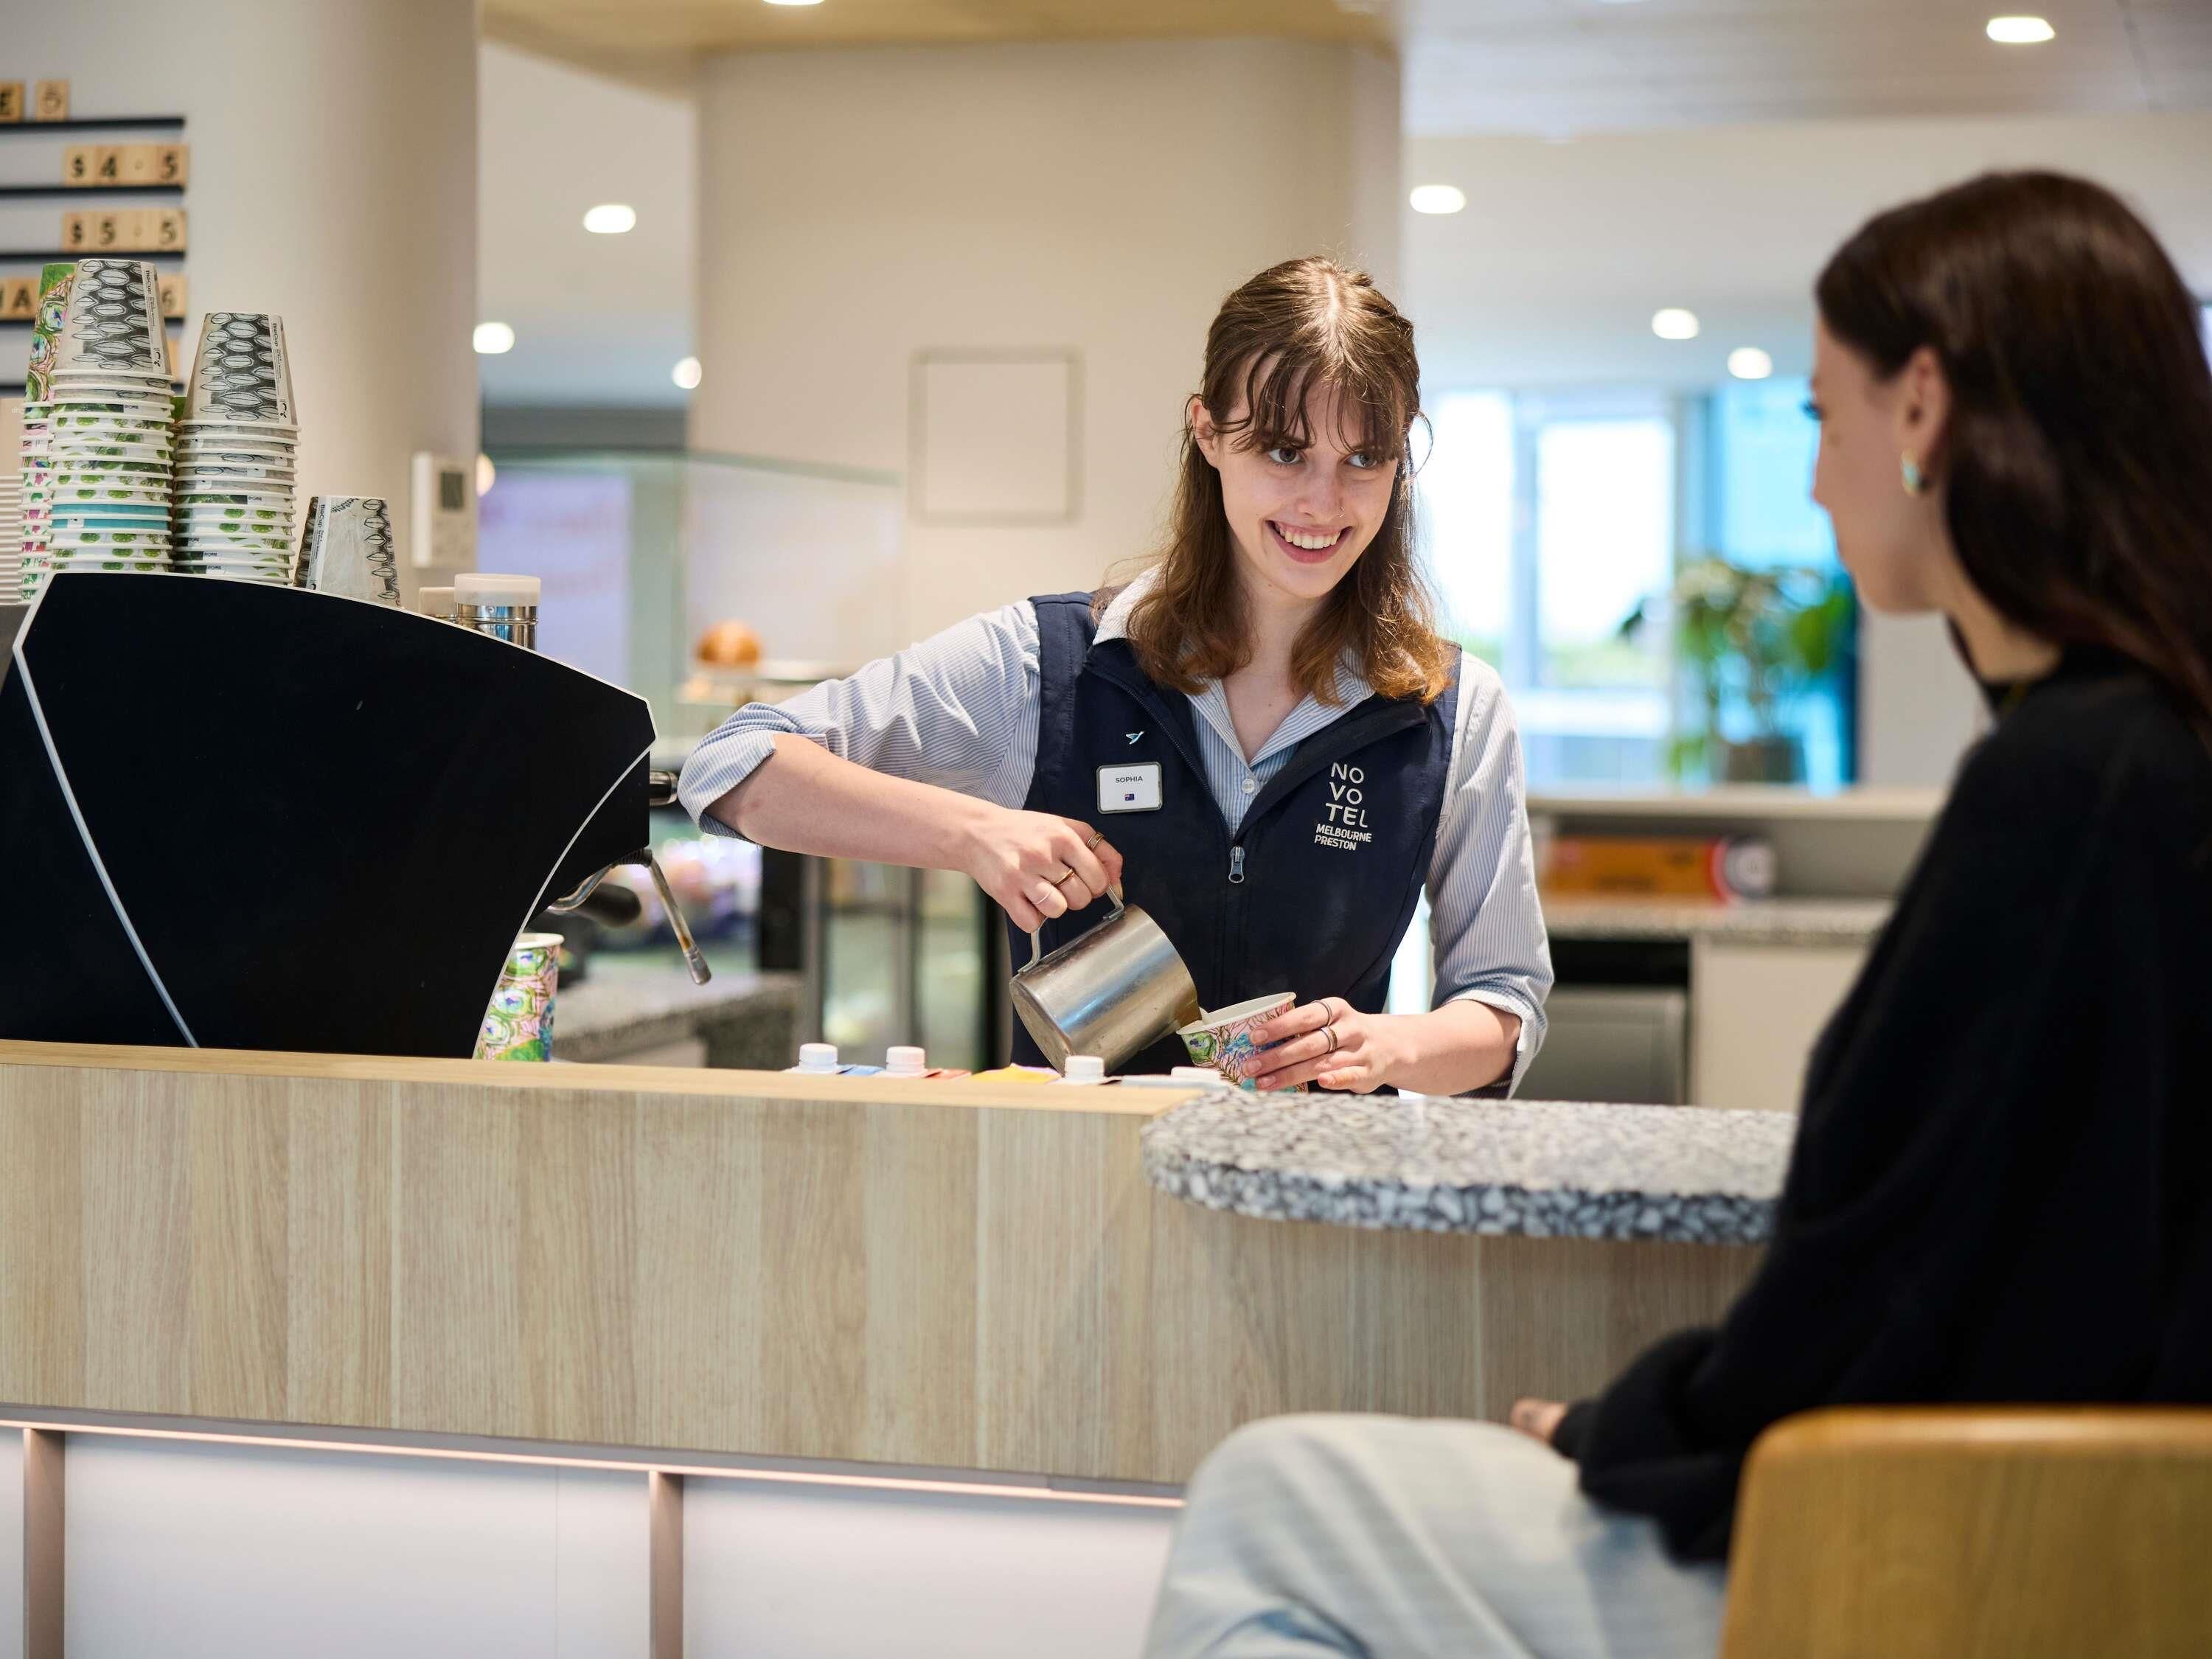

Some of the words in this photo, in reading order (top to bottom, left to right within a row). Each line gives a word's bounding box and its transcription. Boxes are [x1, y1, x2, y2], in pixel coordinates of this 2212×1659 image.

[1115, 775, 1144, 784] SOPHIA
[1330, 762, 1364, 784] NO
[1329, 782, 1363, 804] VO
[1325, 802, 1368, 828] TEL
[1314, 834, 1357, 851] PRESTON
[1315, 824, 1372, 842] MELBOURNE
